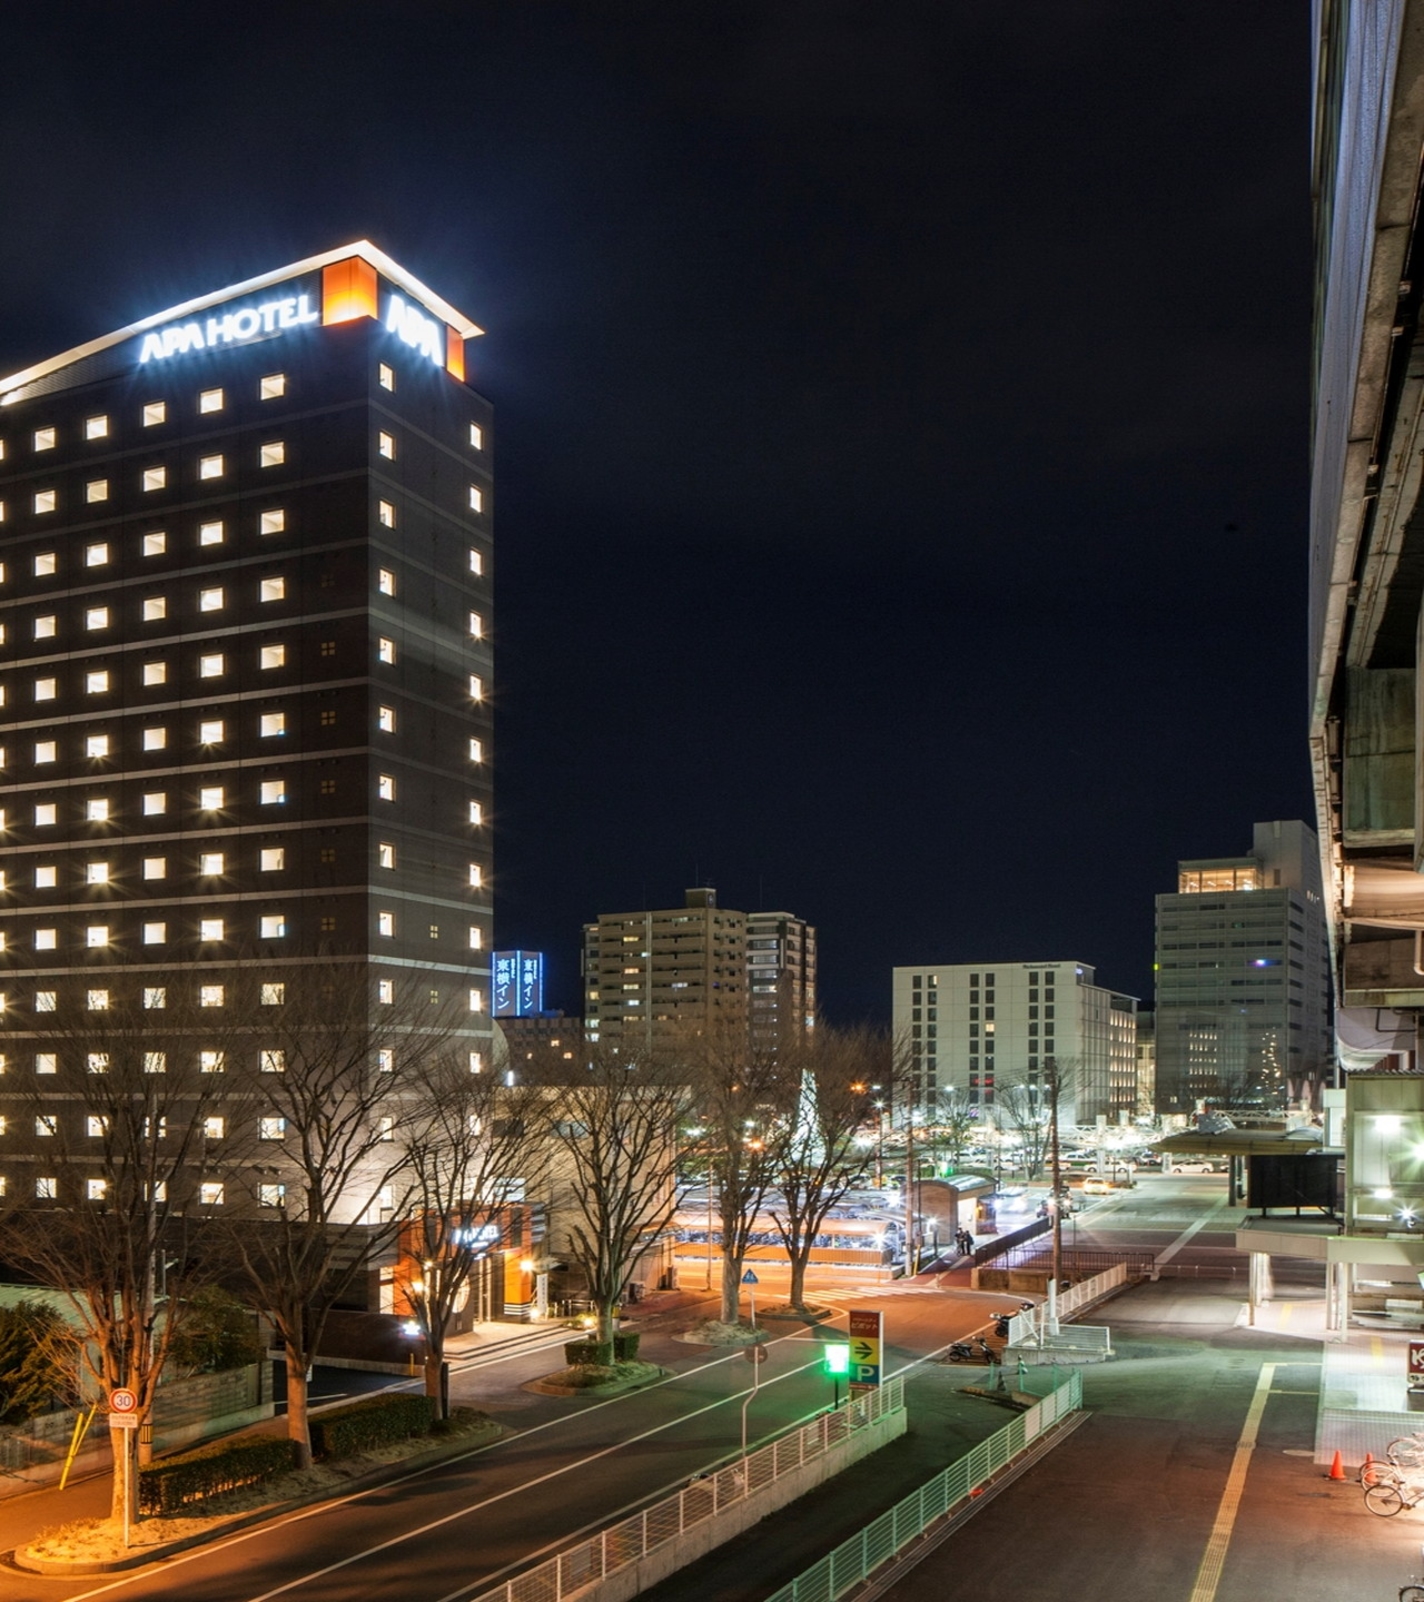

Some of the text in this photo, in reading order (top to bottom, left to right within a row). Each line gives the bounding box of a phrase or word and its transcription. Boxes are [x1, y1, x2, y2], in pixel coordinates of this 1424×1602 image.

[139, 295, 319, 363] APA HOTEL
[386, 294, 445, 367] APA
[496, 958, 511, 1009] 東横イン
[524, 958, 534, 1009] 東横イン
[857, 1365, 875, 1382] P
[116, 1395, 131, 1406] 30
